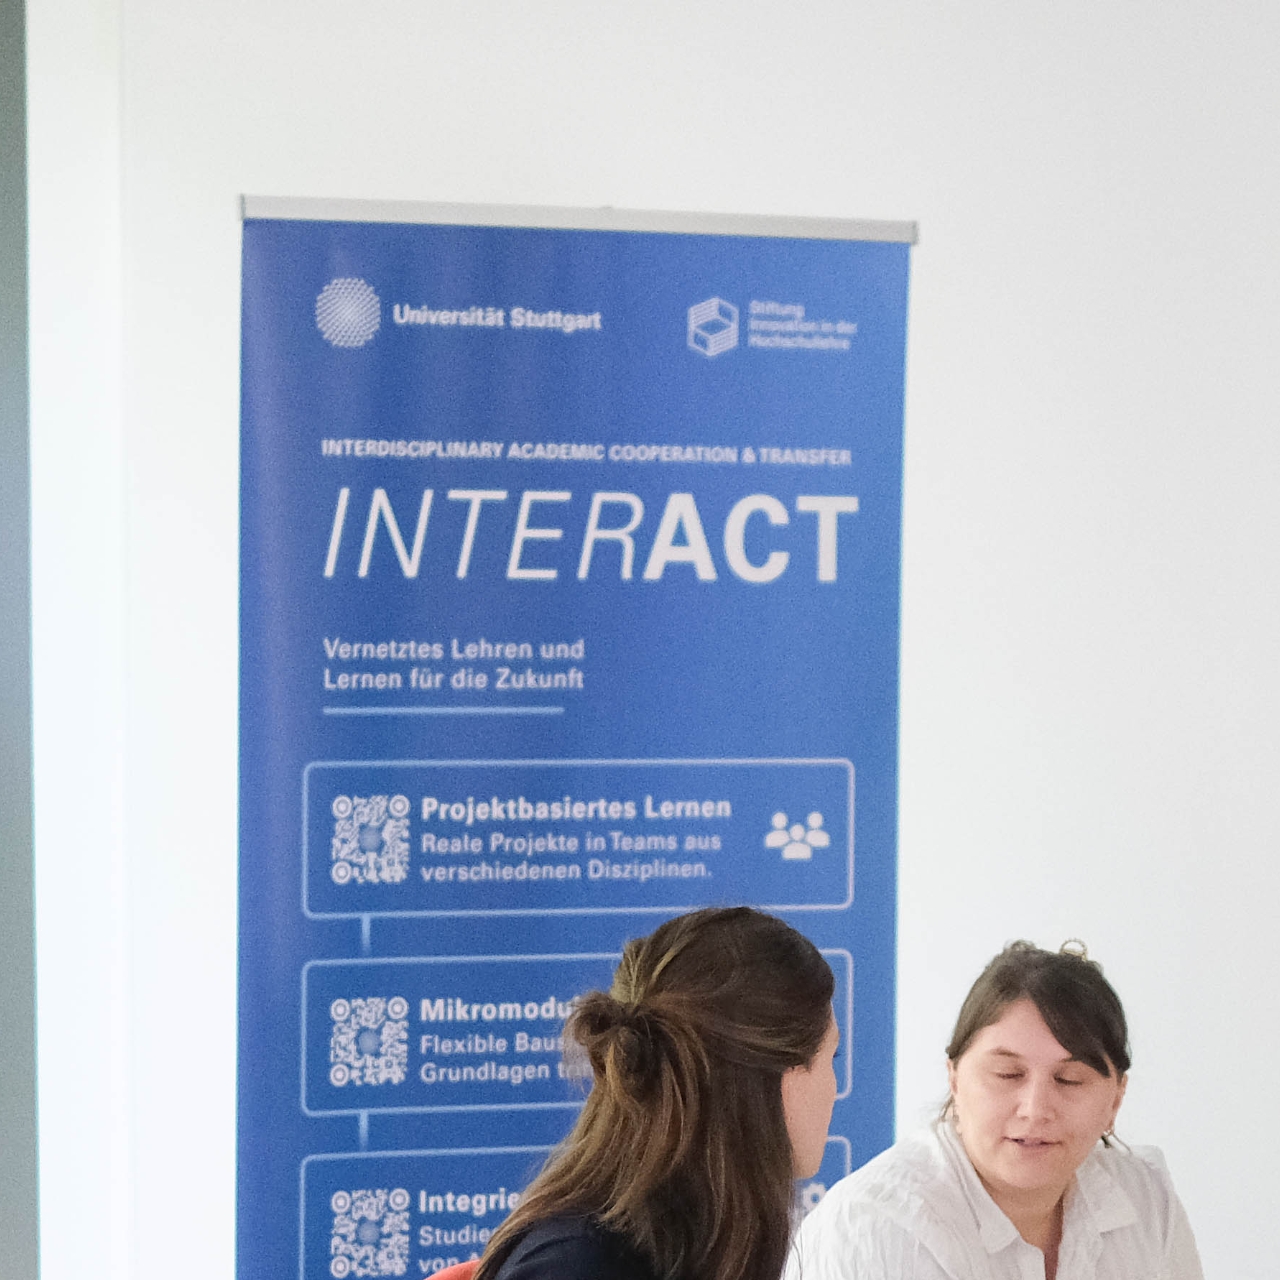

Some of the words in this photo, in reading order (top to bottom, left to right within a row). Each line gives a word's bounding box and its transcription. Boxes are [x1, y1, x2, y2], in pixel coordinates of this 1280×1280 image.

[393, 304, 505, 327] Universität
[510, 307, 602, 333] Stuttgart
[321, 438, 504, 458] INTERDISCIPLINARY
[507, 442, 606, 461] ACADEMIC
[608, 443, 738, 464] COOPERATION
[741, 446, 756, 464] &
[759, 446, 853, 466] TRANSFER
[323, 487, 860, 584] INTERACT
[322, 637, 445, 660] Vernetztes
[451, 637, 533, 660] Lehren
[540, 638, 586, 660] und
[323, 667, 403, 690] Lernen
[410, 666, 445, 689] für
[450, 666, 489, 689] die
[495, 666, 585, 689] Zukunft
[421, 795, 637, 826] Projektbasiertes
[644, 794, 732, 818] Lernen
[422, 832, 483, 854] Reale
[490, 832, 580, 857] Projekte
[585, 831, 607, 851] in
[610, 830, 678, 851] Teams
[684, 833, 721, 851] aus
[421, 860, 581, 882] verschiedenen
[587, 858, 712, 883] Disziplinen.
[420, 995, 581, 1022] Mikromodu
[420, 1033, 509, 1055] Flexible
[420, 1060, 551, 1086] Grundlagen
[419, 1187, 521, 1217] Integrie
[419, 1223, 497, 1247] Studie
